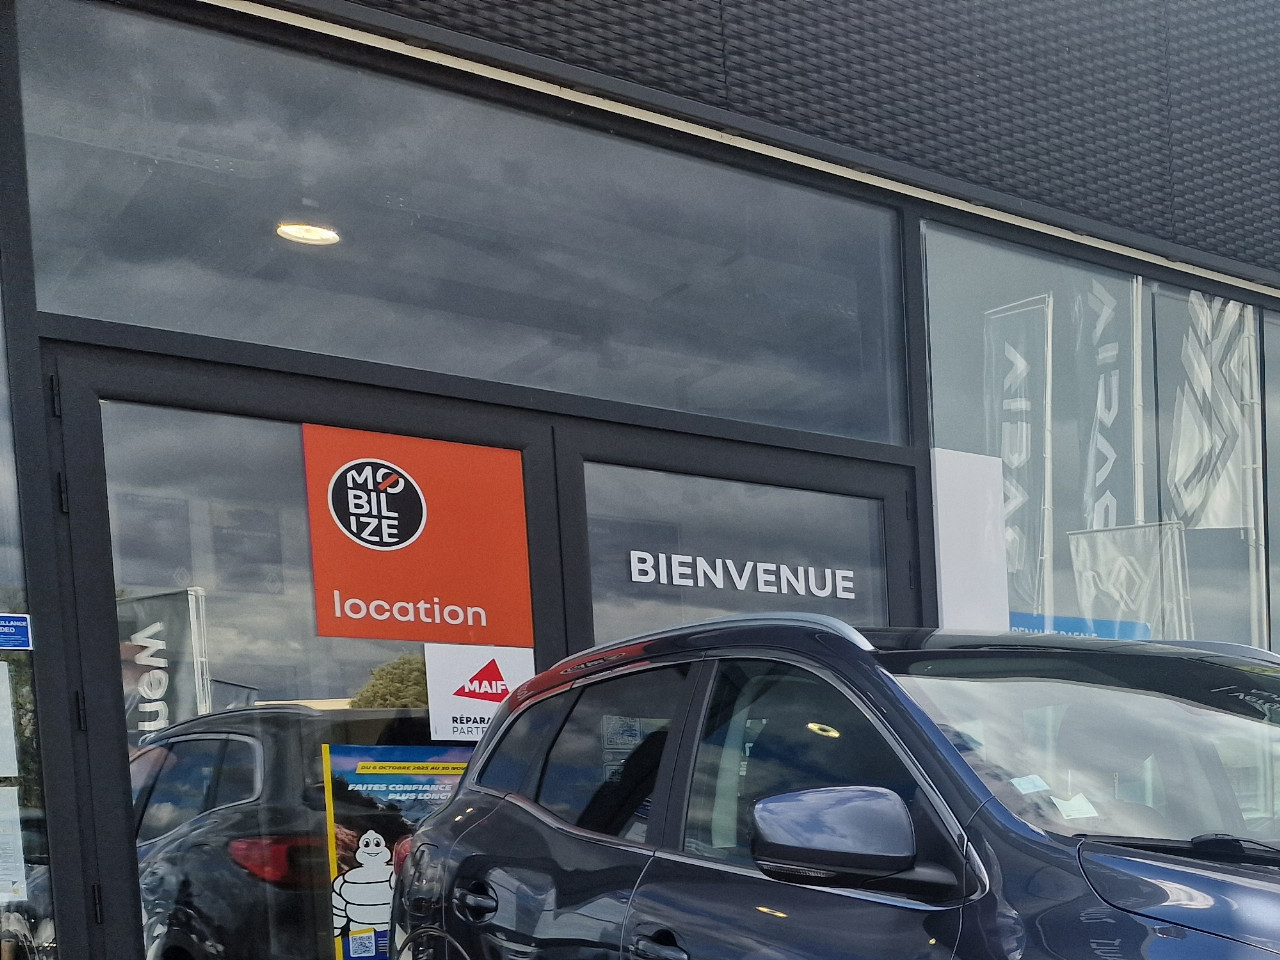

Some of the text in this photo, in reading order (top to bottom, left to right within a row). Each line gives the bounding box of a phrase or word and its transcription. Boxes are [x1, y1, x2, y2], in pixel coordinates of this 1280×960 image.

[630, 550, 856, 600] BIENVENUE
[333, 589, 487, 627] location
[464, 680, 507, 694] MAIF
[347, 783, 387, 791] FAITES
[387, 792, 417, 800] PLUS
